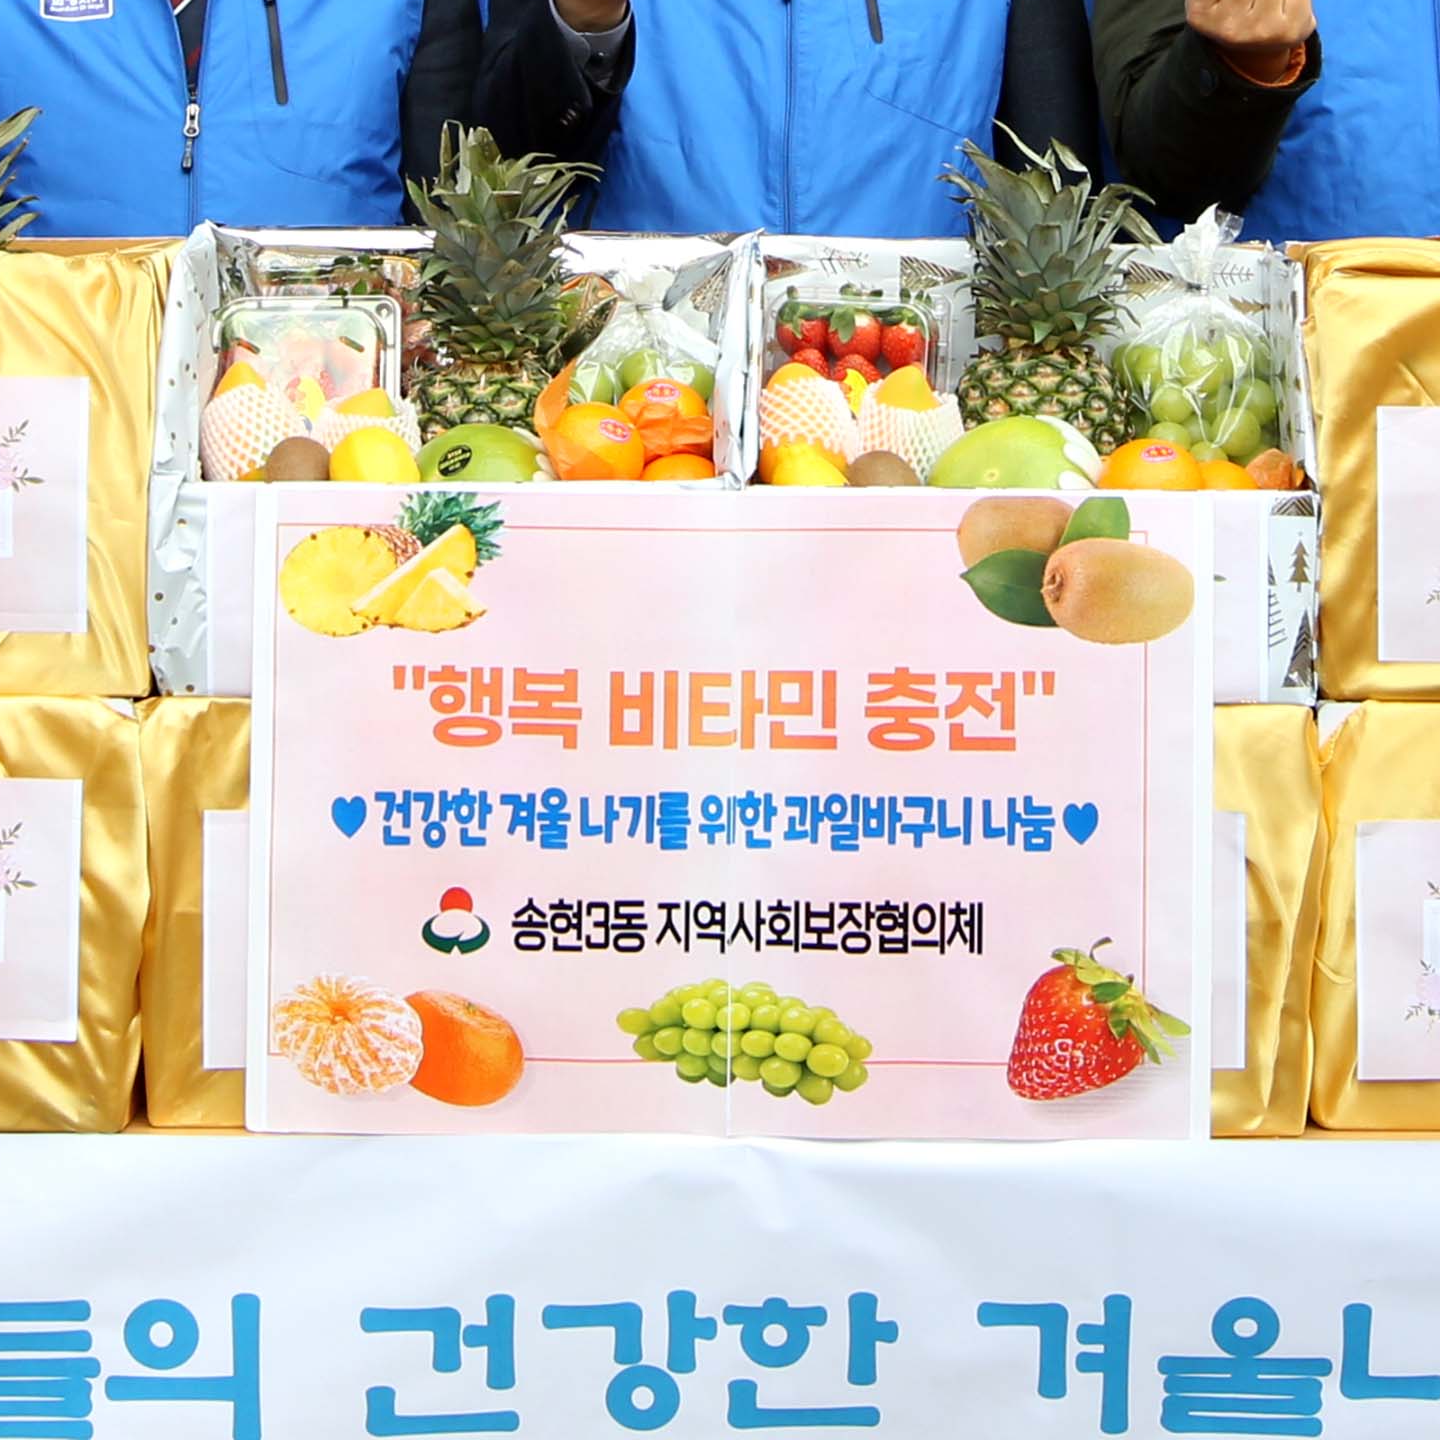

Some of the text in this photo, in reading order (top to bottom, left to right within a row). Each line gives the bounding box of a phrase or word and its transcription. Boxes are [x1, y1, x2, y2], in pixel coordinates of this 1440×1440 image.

[392, 664, 1056, 753] "행복 비타민 충전"
[374, 788, 1054, 854] 건강한 겨울 나기를 위한 과일바구니 나눔
[512, 898, 984, 956] 송현3동 지역사회보장협의체
[361, 1289, 900, 1436] 건강한
